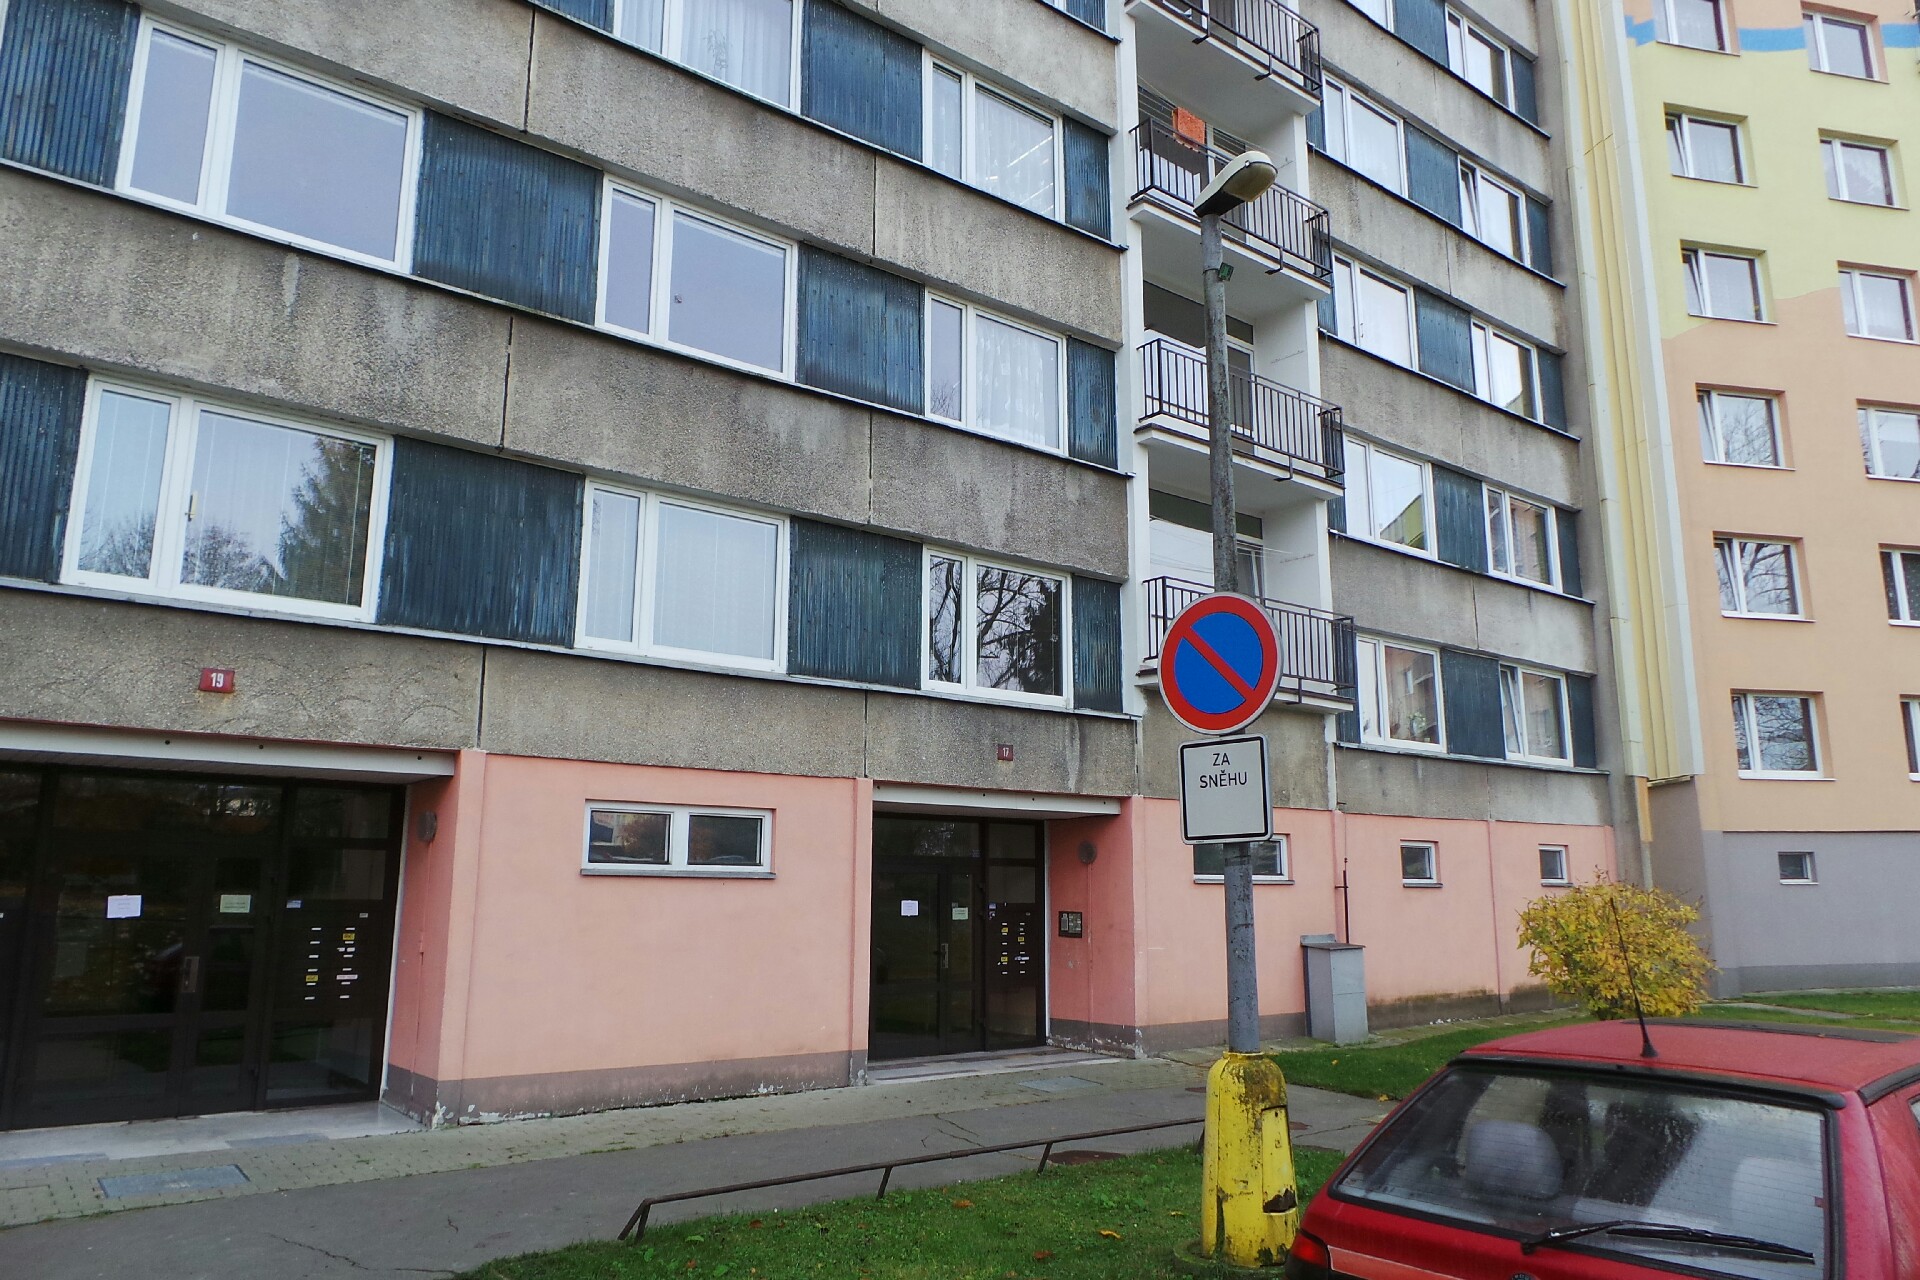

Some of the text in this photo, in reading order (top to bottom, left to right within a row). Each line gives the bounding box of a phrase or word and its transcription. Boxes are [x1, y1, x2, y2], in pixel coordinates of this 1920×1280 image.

[211, 672, 224, 688] 19
[1002, 747, 1009, 757] 17
[1212, 752, 1230, 766] ZA
[1199, 769, 1247, 788] SNĚHU
